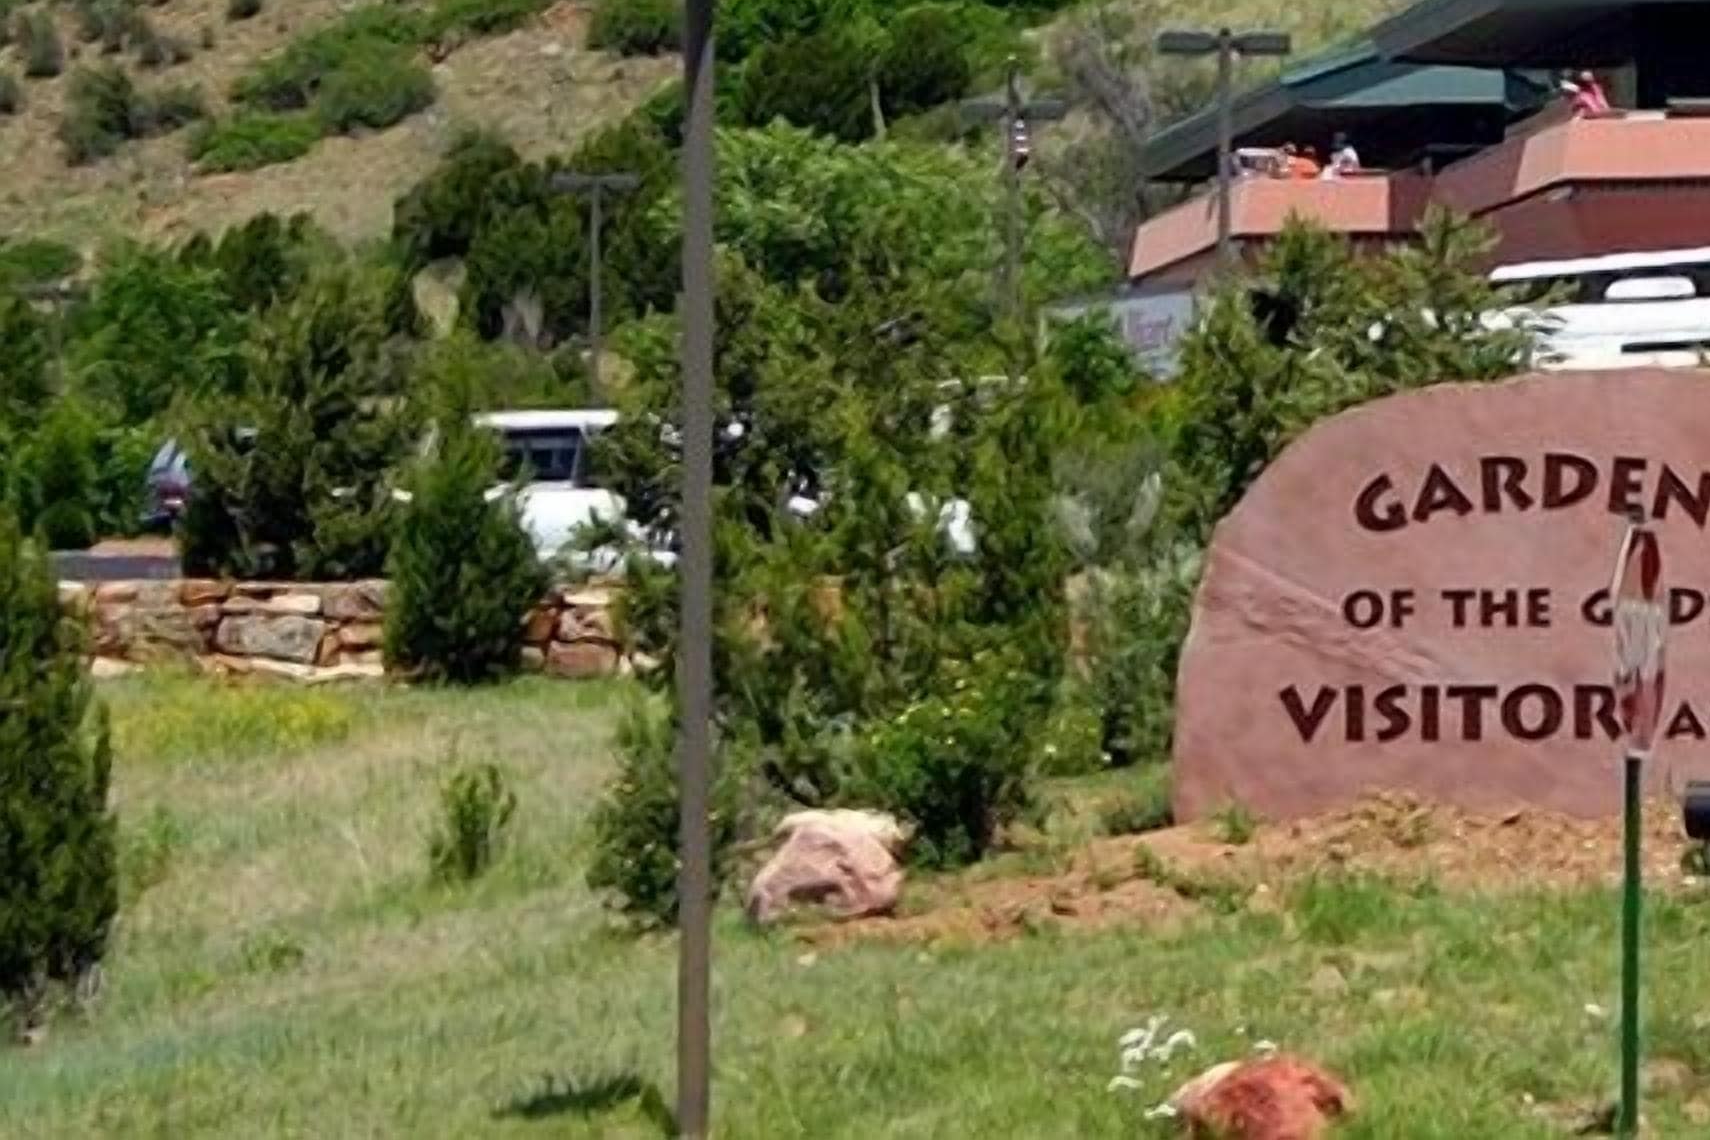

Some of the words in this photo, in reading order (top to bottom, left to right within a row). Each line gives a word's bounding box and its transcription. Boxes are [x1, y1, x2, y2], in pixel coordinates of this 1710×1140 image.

[1342, 589, 1415, 629] OF
[1442, 588, 1551, 627] THE
[1279, 683, 1623, 743] VISITOR
